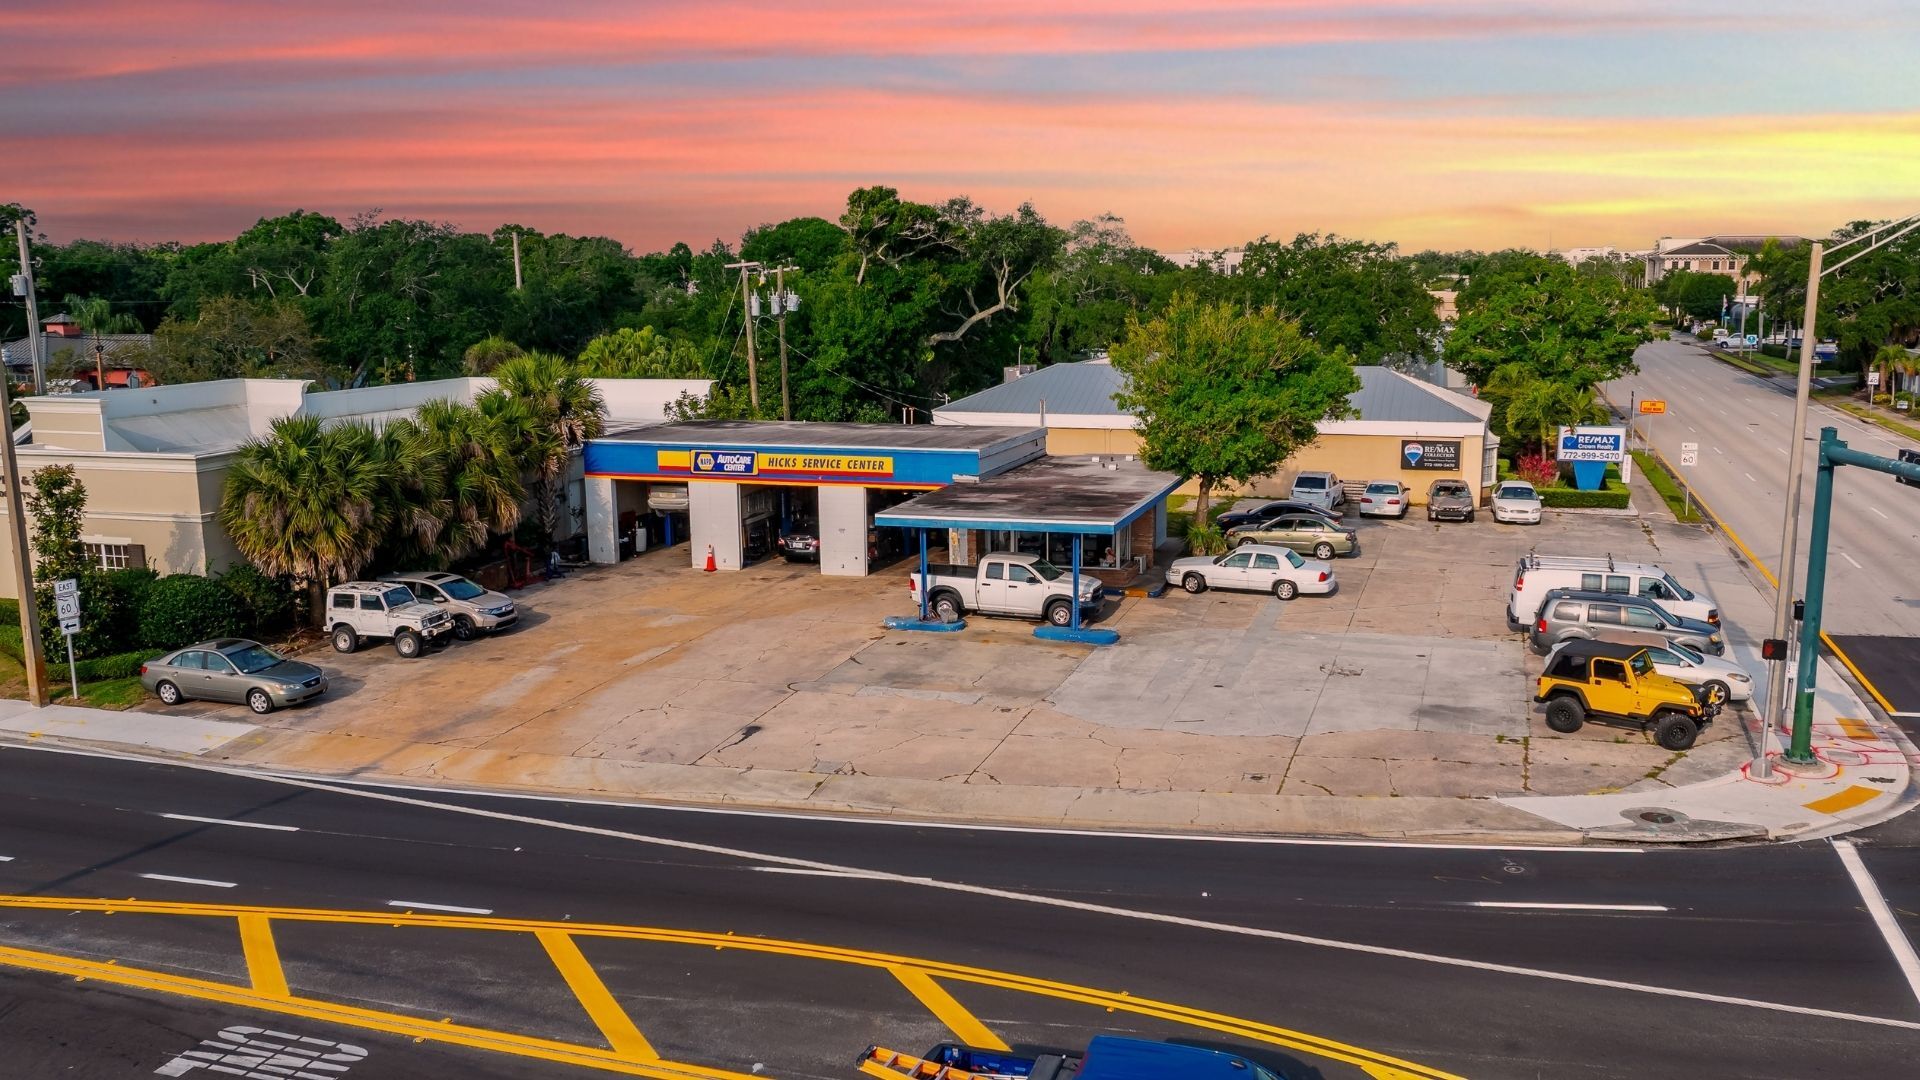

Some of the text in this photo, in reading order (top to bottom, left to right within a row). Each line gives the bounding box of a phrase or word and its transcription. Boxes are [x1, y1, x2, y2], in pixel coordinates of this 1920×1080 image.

[1578, 436, 1615, 444] RE/MAX
[1563, 451, 1619, 460] 772-999-5470
[1682, 456, 1694, 464] 60
[724, 463, 746, 471] CENTER
[768, 457, 885, 470] HICKS SERVICE CENTER
[58, 582, 73, 591] EAST
[61, 603, 72, 615] 60
